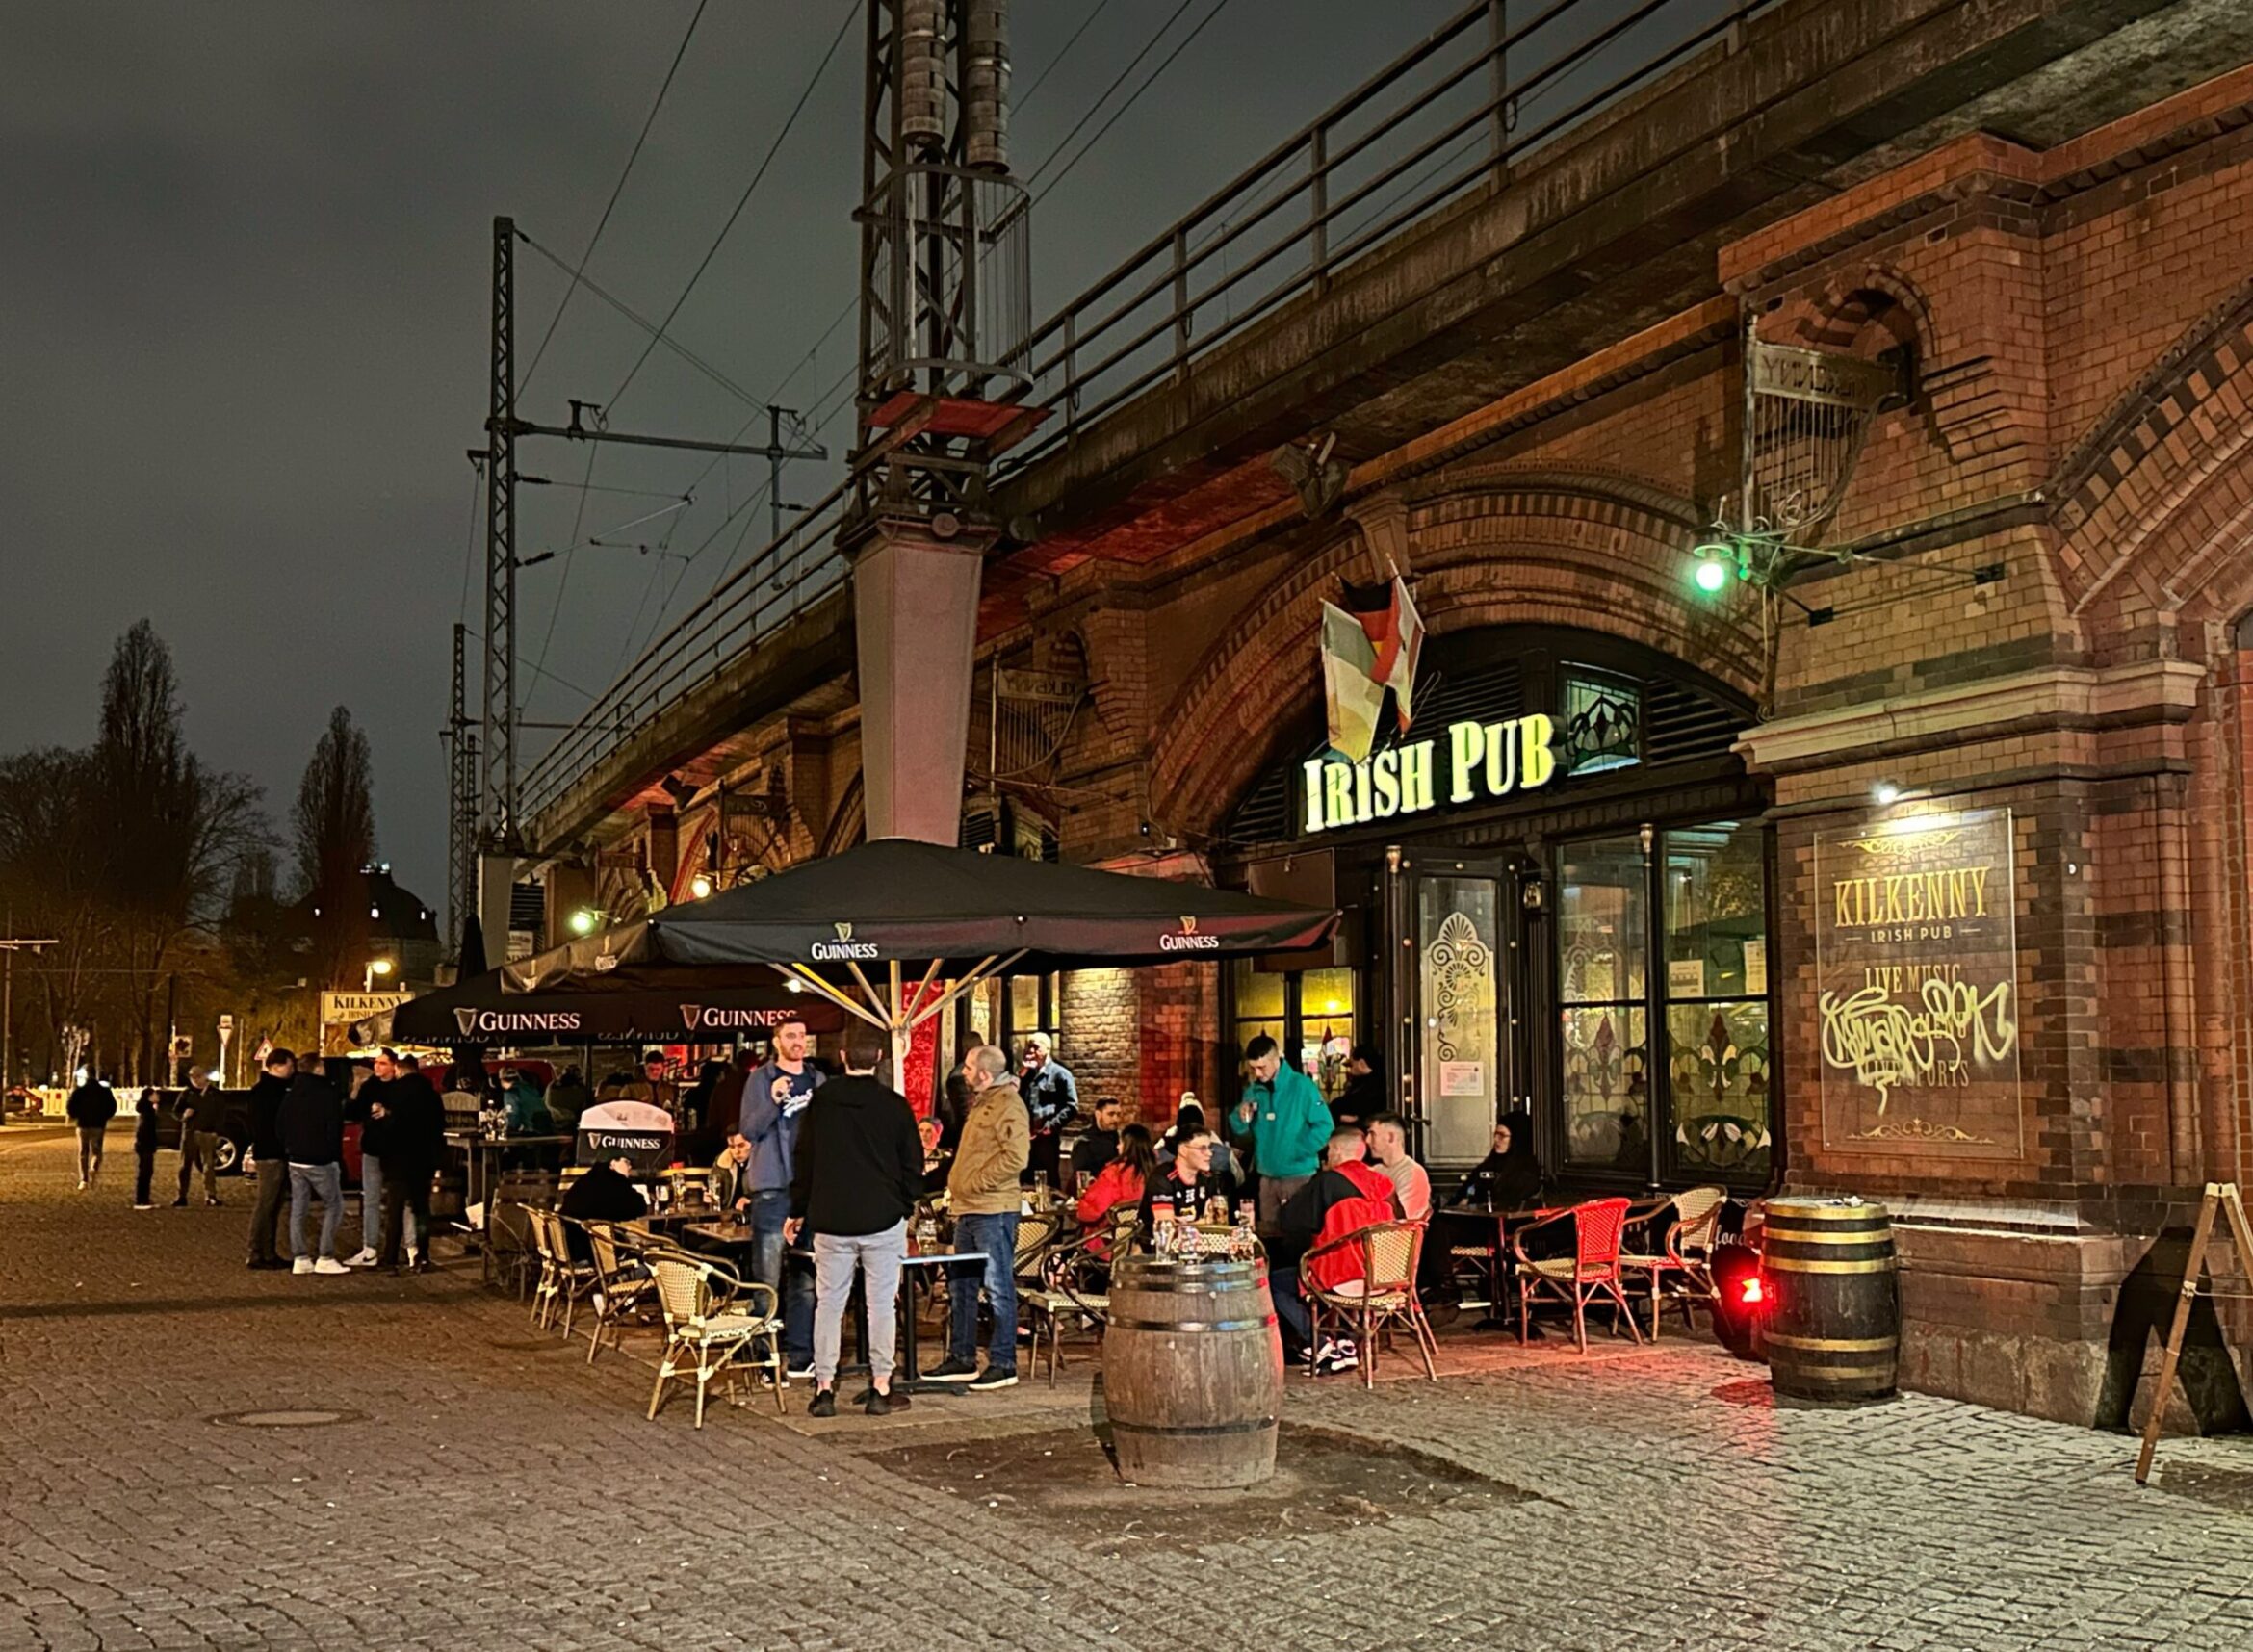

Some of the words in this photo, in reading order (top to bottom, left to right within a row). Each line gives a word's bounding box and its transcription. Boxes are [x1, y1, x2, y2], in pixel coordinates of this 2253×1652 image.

[1303, 739, 1436, 832] IRISH
[1448, 713, 1557, 803] PUB
[1834, 866, 1990, 927] KILKENNY
[1159, 934, 1220, 951] GUINNESS
[1871, 929, 1913, 943] IRISH
[1920, 925, 1953, 941] PUB
[811, 942, 879, 961] GUINNESS
[1865, 967, 1903, 993] LIVE
[1907, 964, 1961, 993] MUSIC
[479, 1011, 581, 1031] GUINNESS
[602, 1135, 661, 1149] GUINNESS
